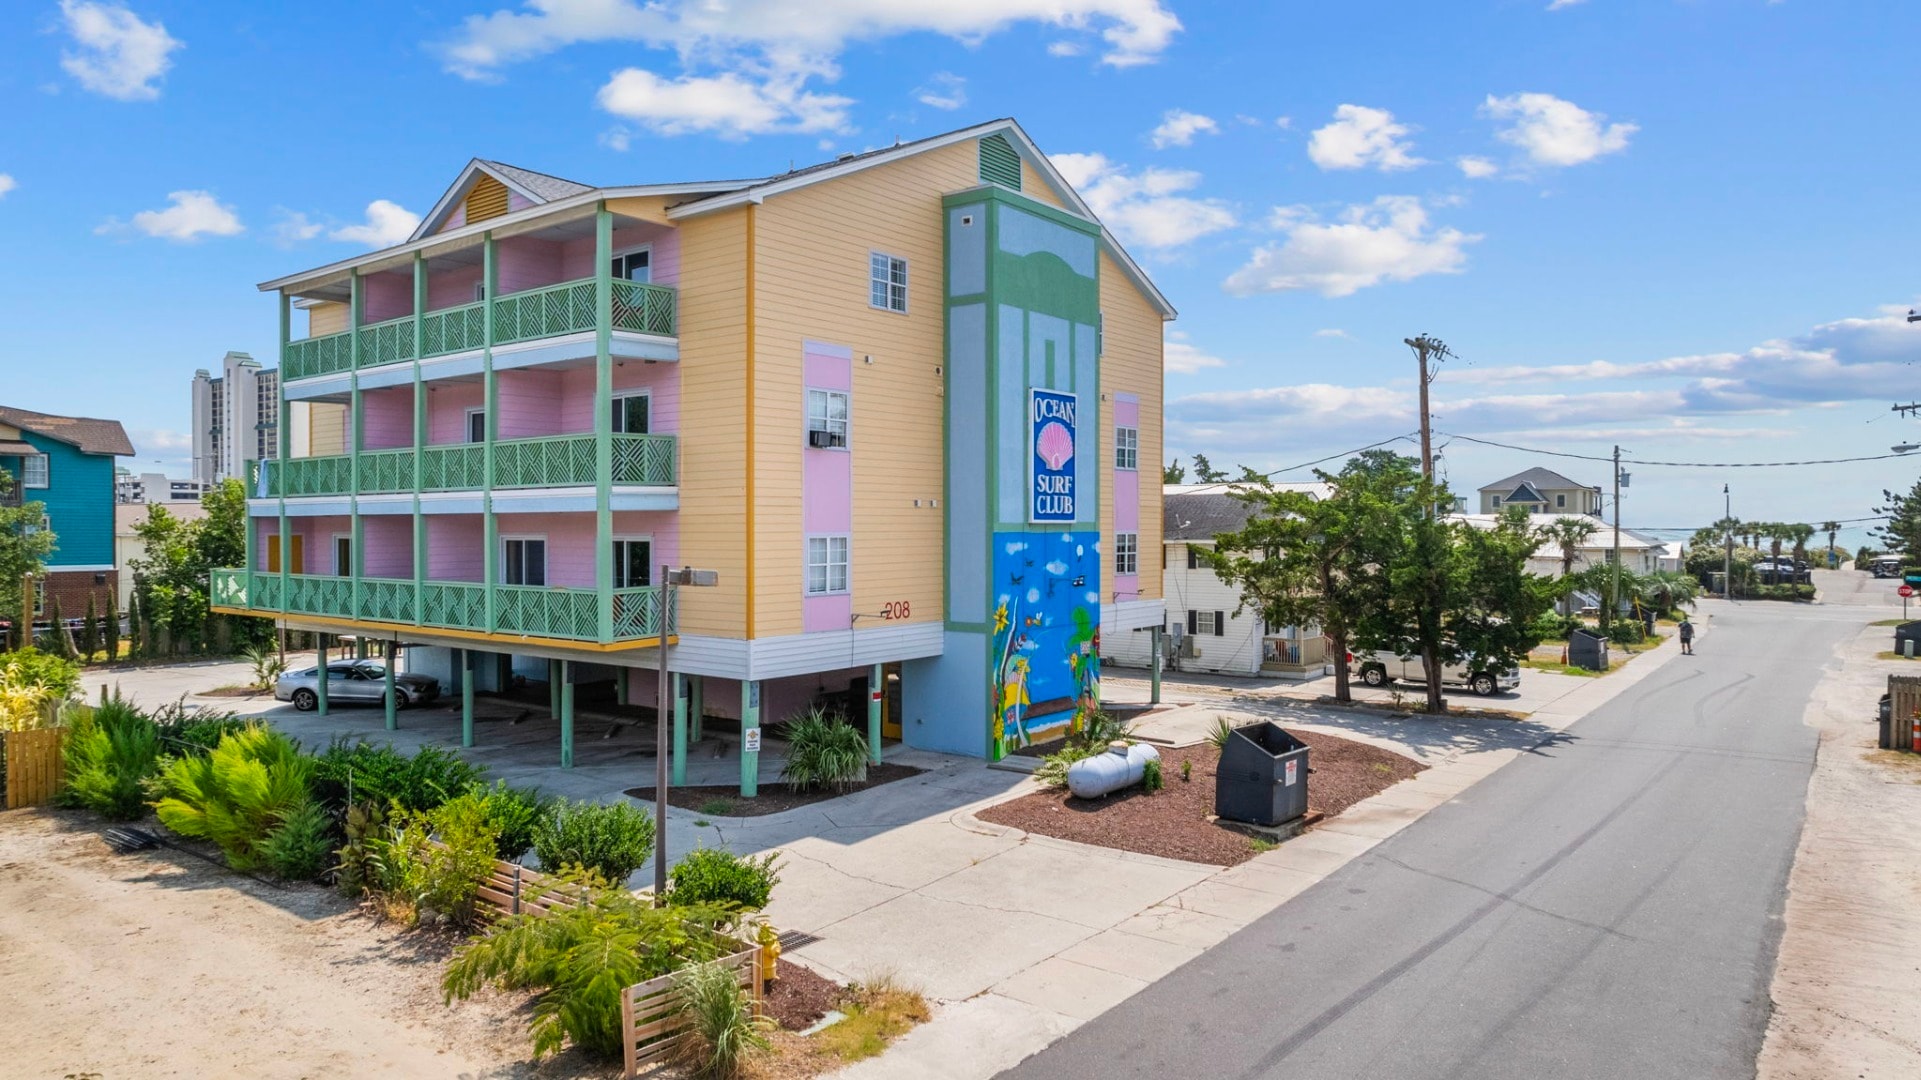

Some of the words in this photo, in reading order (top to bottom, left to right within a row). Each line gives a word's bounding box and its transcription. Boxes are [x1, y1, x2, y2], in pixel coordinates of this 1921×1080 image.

[1034, 397, 1075, 428] OCEAN
[1037, 474, 1073, 494] SURF
[1036, 495, 1073, 514] CLUB
[885, 601, 910, 620] 208
